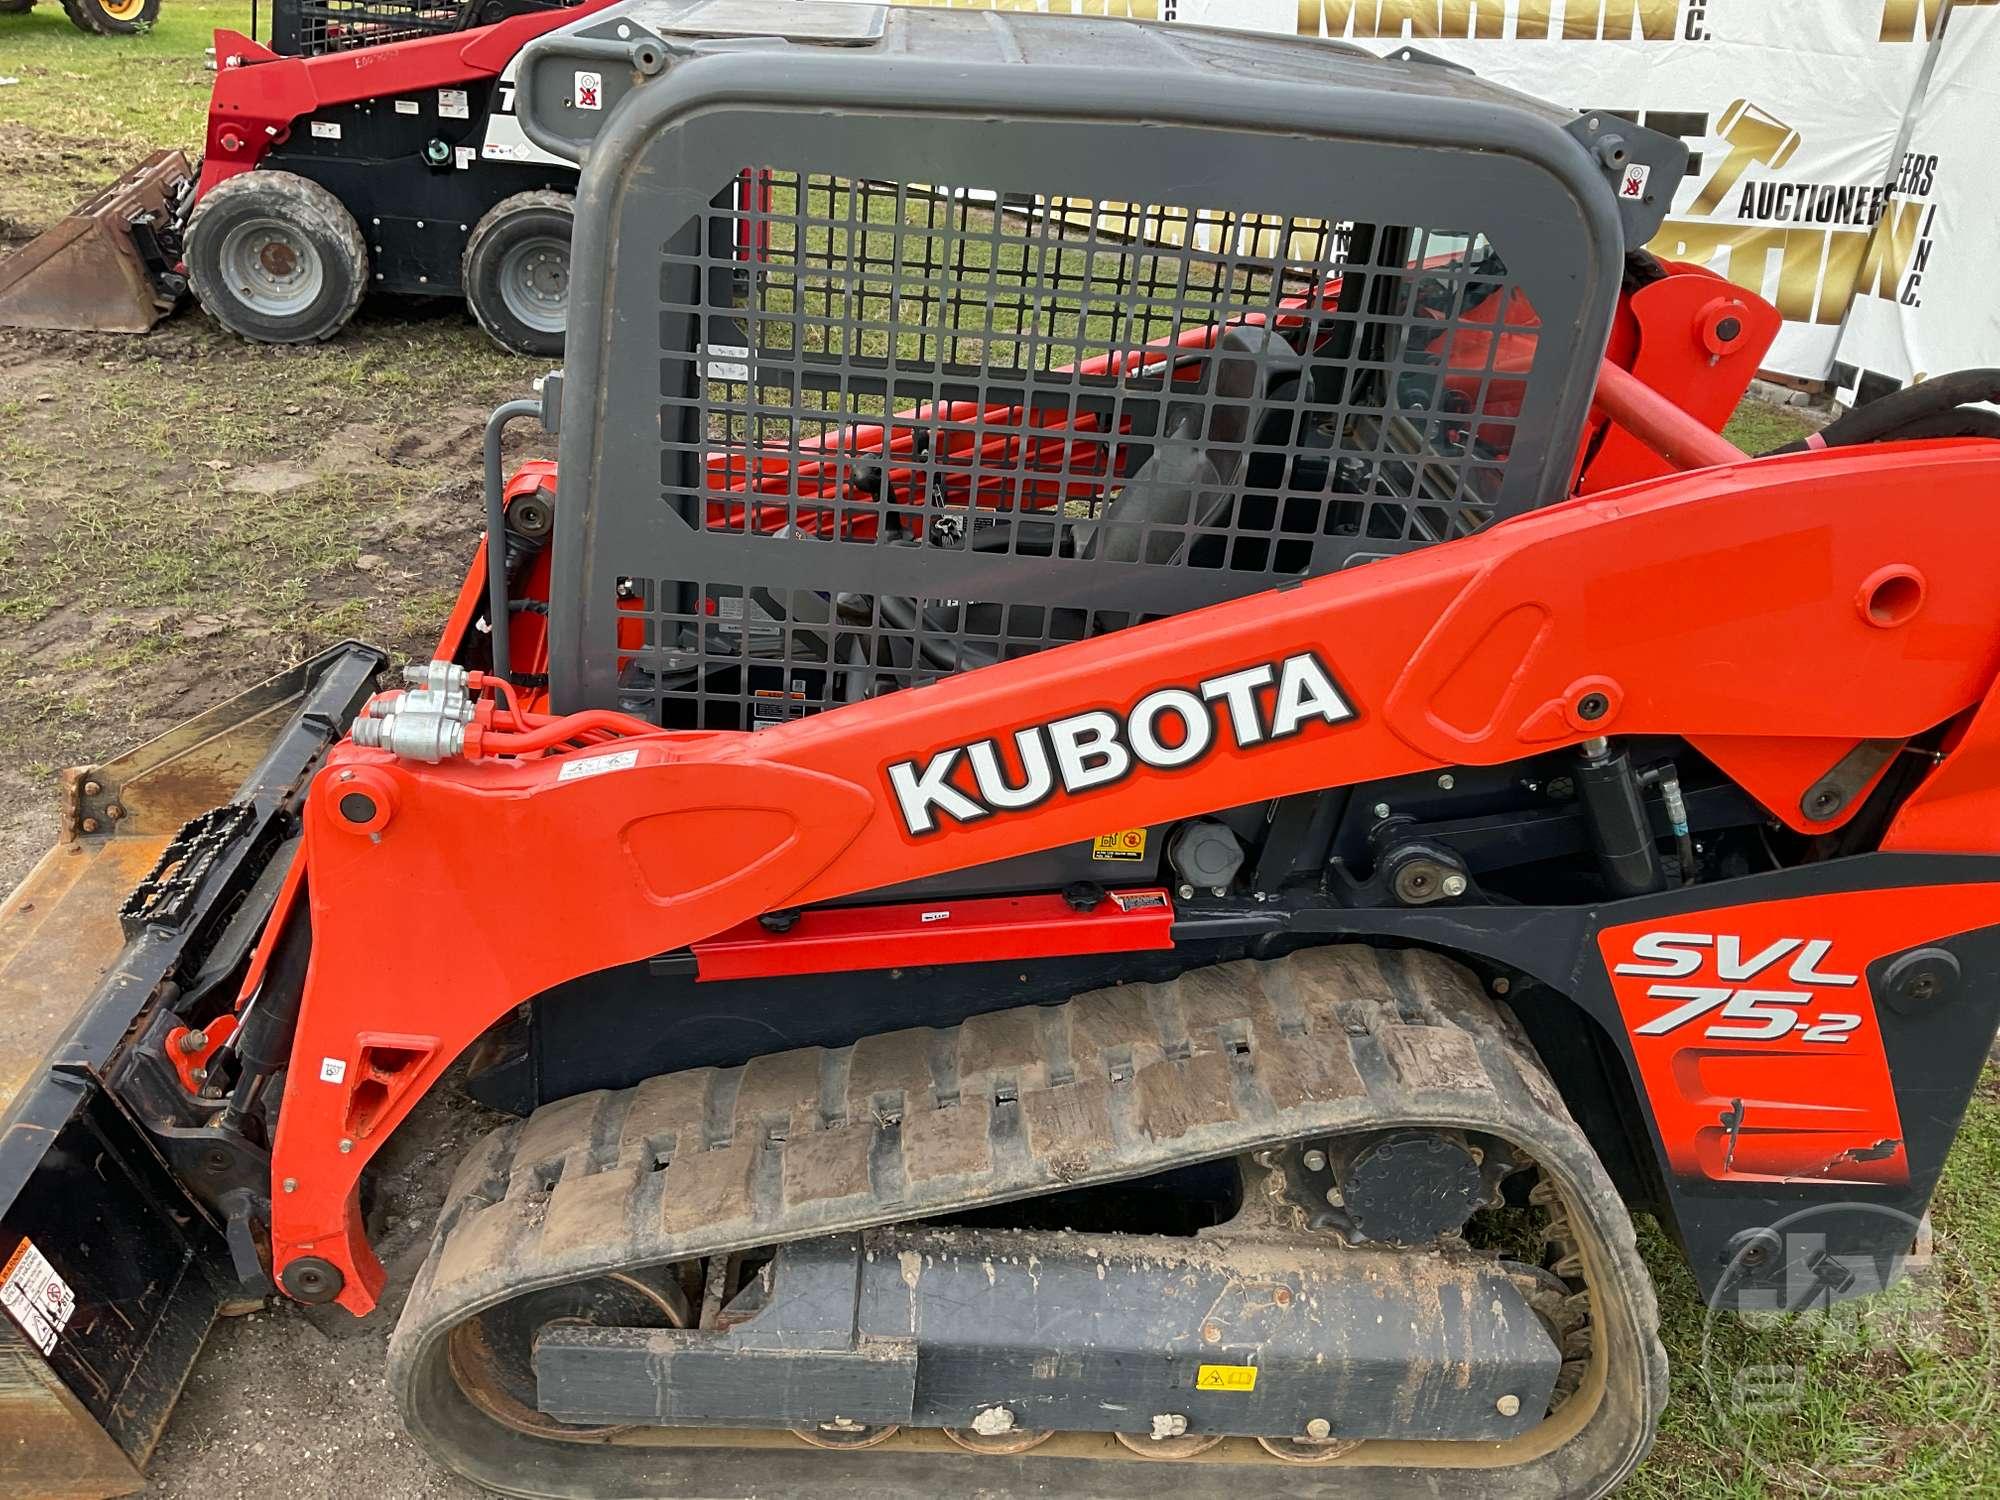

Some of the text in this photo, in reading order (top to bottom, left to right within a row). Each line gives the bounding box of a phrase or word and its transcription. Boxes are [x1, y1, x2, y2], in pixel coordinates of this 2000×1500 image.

[1901, 203, 1938, 308] INC.
[887, 652, 1354, 835] KUBOTA
[1613, 931, 1859, 987] SVL
[1632, 984, 1862, 1042] 75-2
